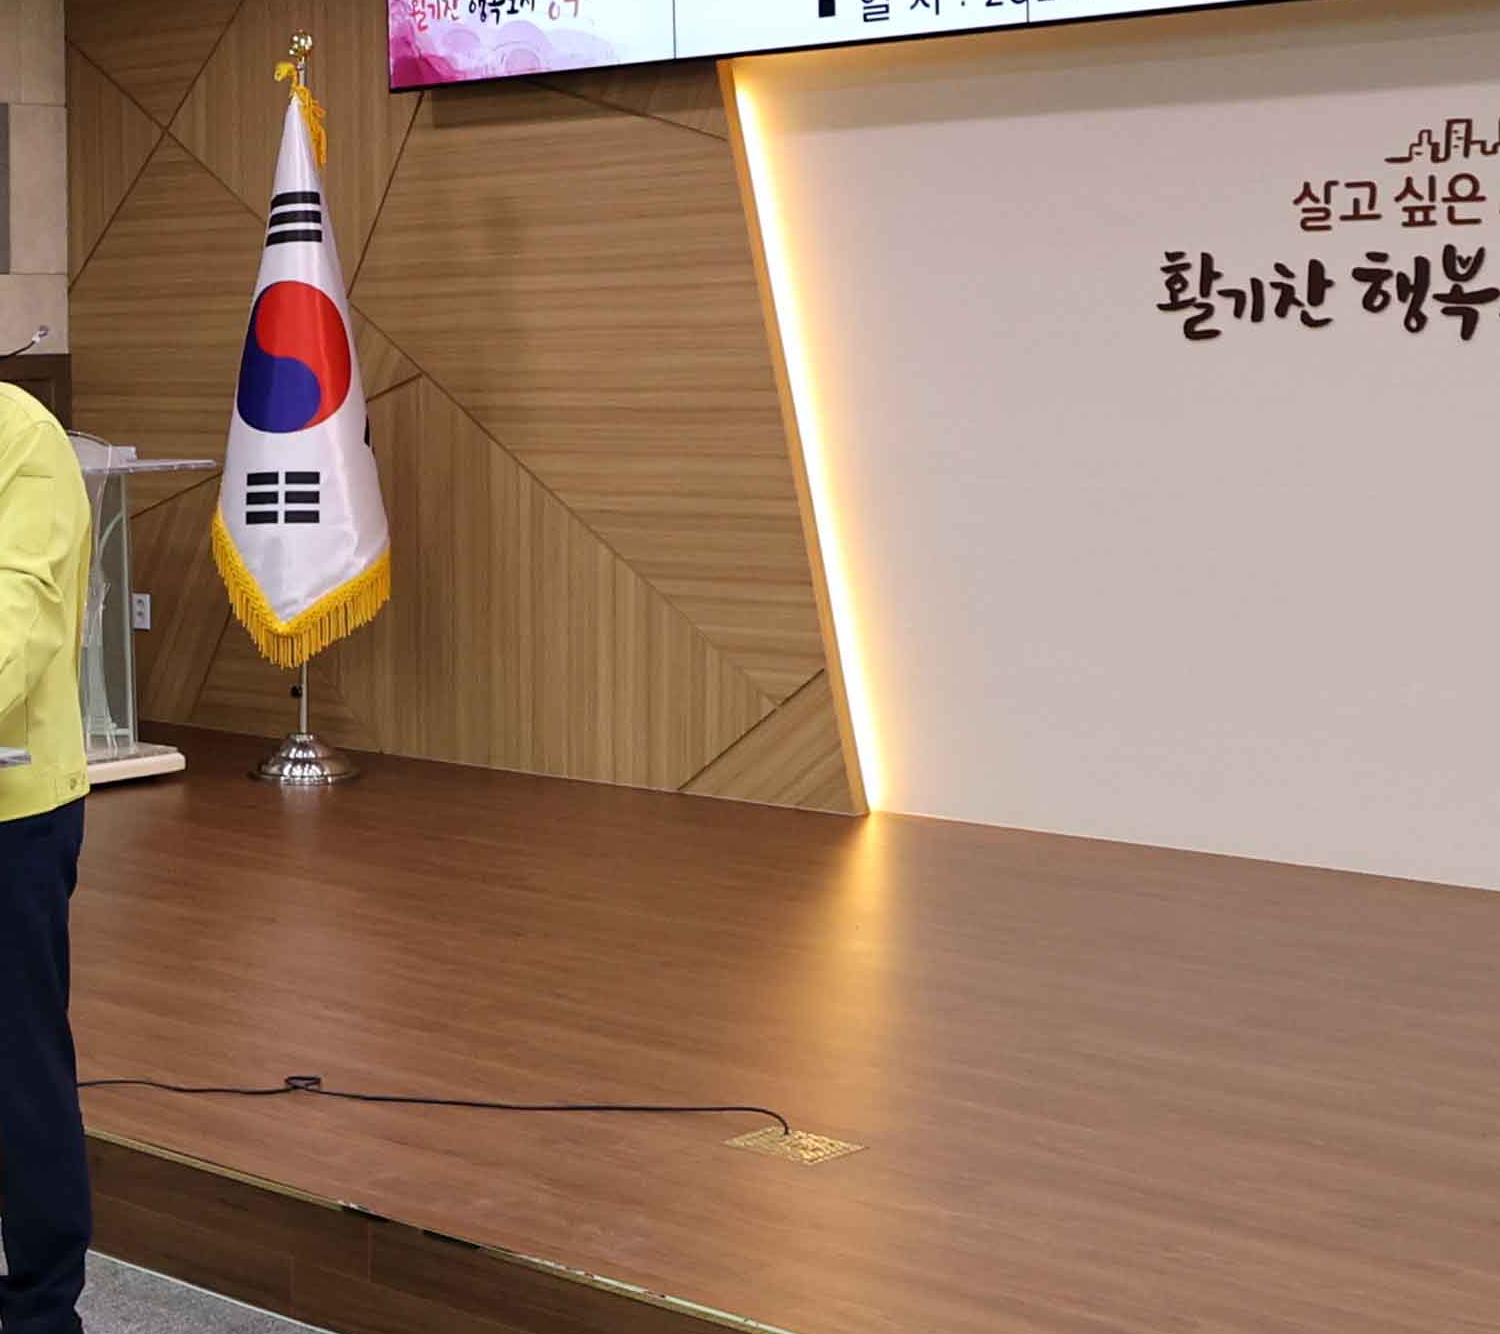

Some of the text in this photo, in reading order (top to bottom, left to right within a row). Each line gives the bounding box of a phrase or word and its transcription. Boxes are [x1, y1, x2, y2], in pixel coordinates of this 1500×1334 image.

[1292, 179, 1383, 232] 살고
[1394, 172, 1487, 229] 싶은
[1155, 249, 1335, 342] 활기찬
